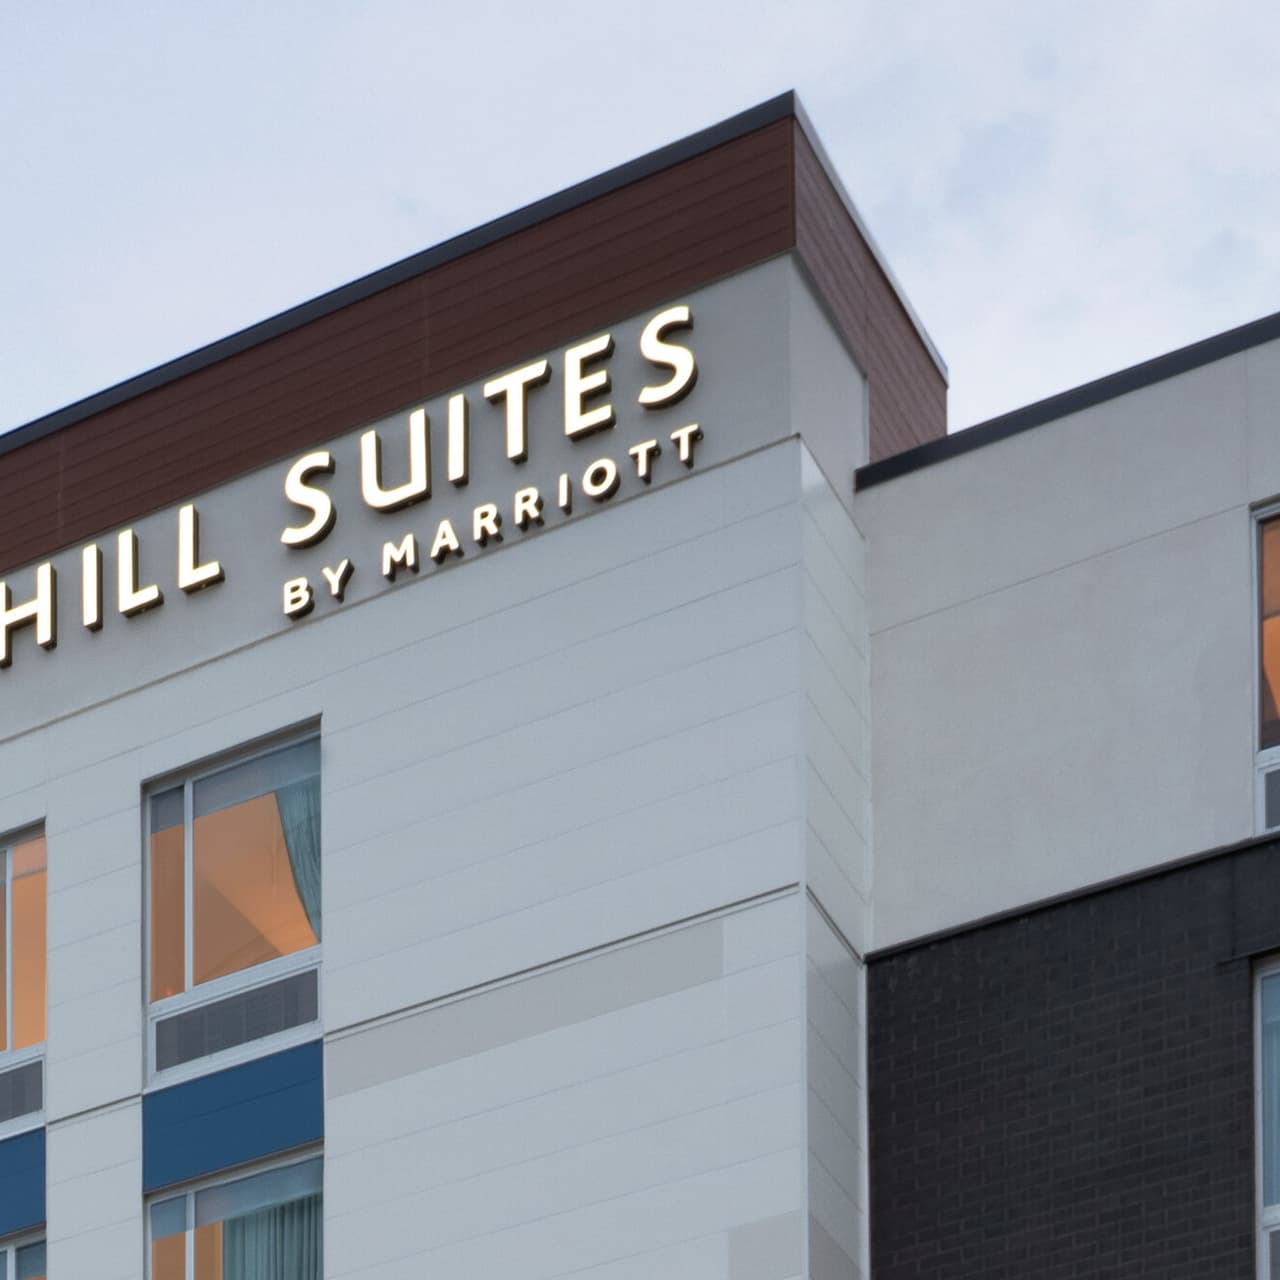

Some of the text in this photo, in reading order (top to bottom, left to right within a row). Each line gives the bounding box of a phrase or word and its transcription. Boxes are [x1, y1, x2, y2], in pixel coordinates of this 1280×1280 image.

[280, 306, 697, 547] SUITES
[282, 424, 701, 617] BY MARRIOTT
